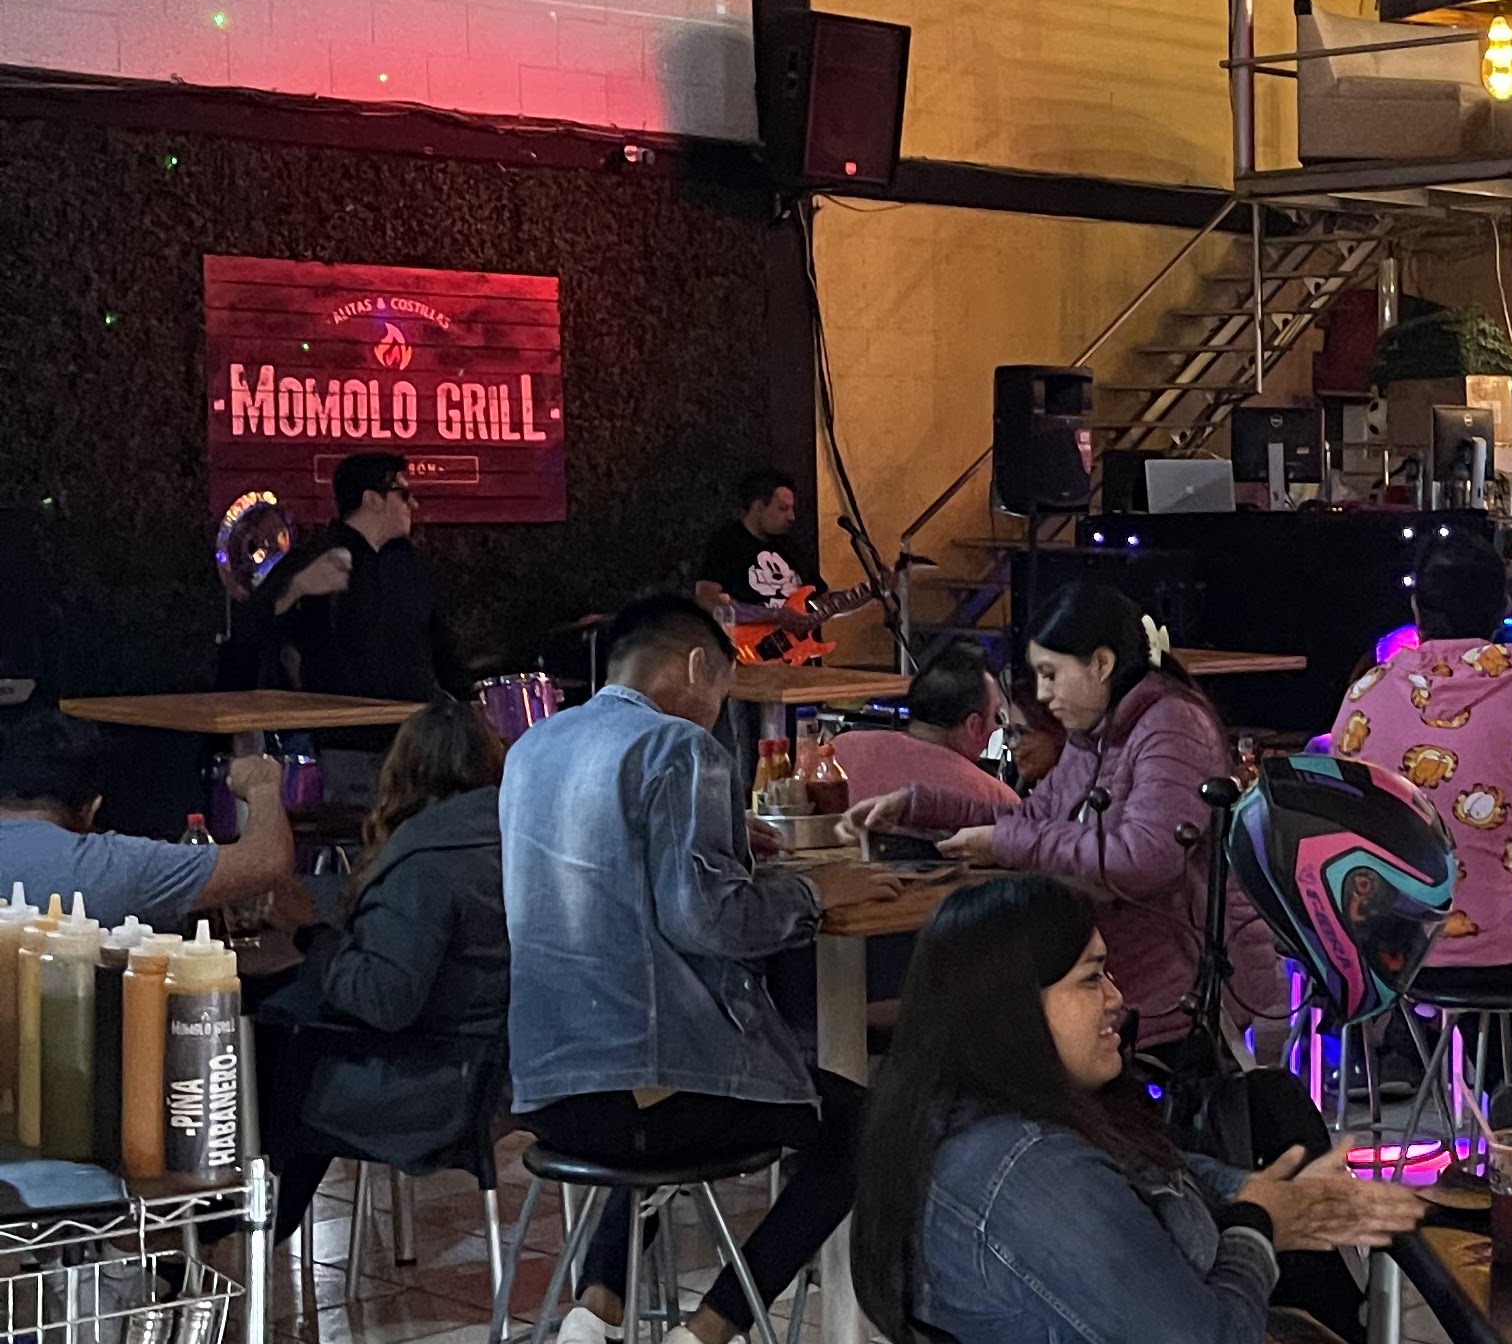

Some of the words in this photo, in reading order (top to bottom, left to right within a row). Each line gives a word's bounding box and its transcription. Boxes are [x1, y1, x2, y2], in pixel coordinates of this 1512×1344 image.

[332, 298, 373, 325] ALITAS
[390, 297, 451, 330] COSTILLAS
[229, 363, 418, 439] MOMOLO
[437, 374, 547, 441] GRILL
[167, 1078, 205, 1128] PIÑA
[208, 1053, 238, 1167] HABANERO
